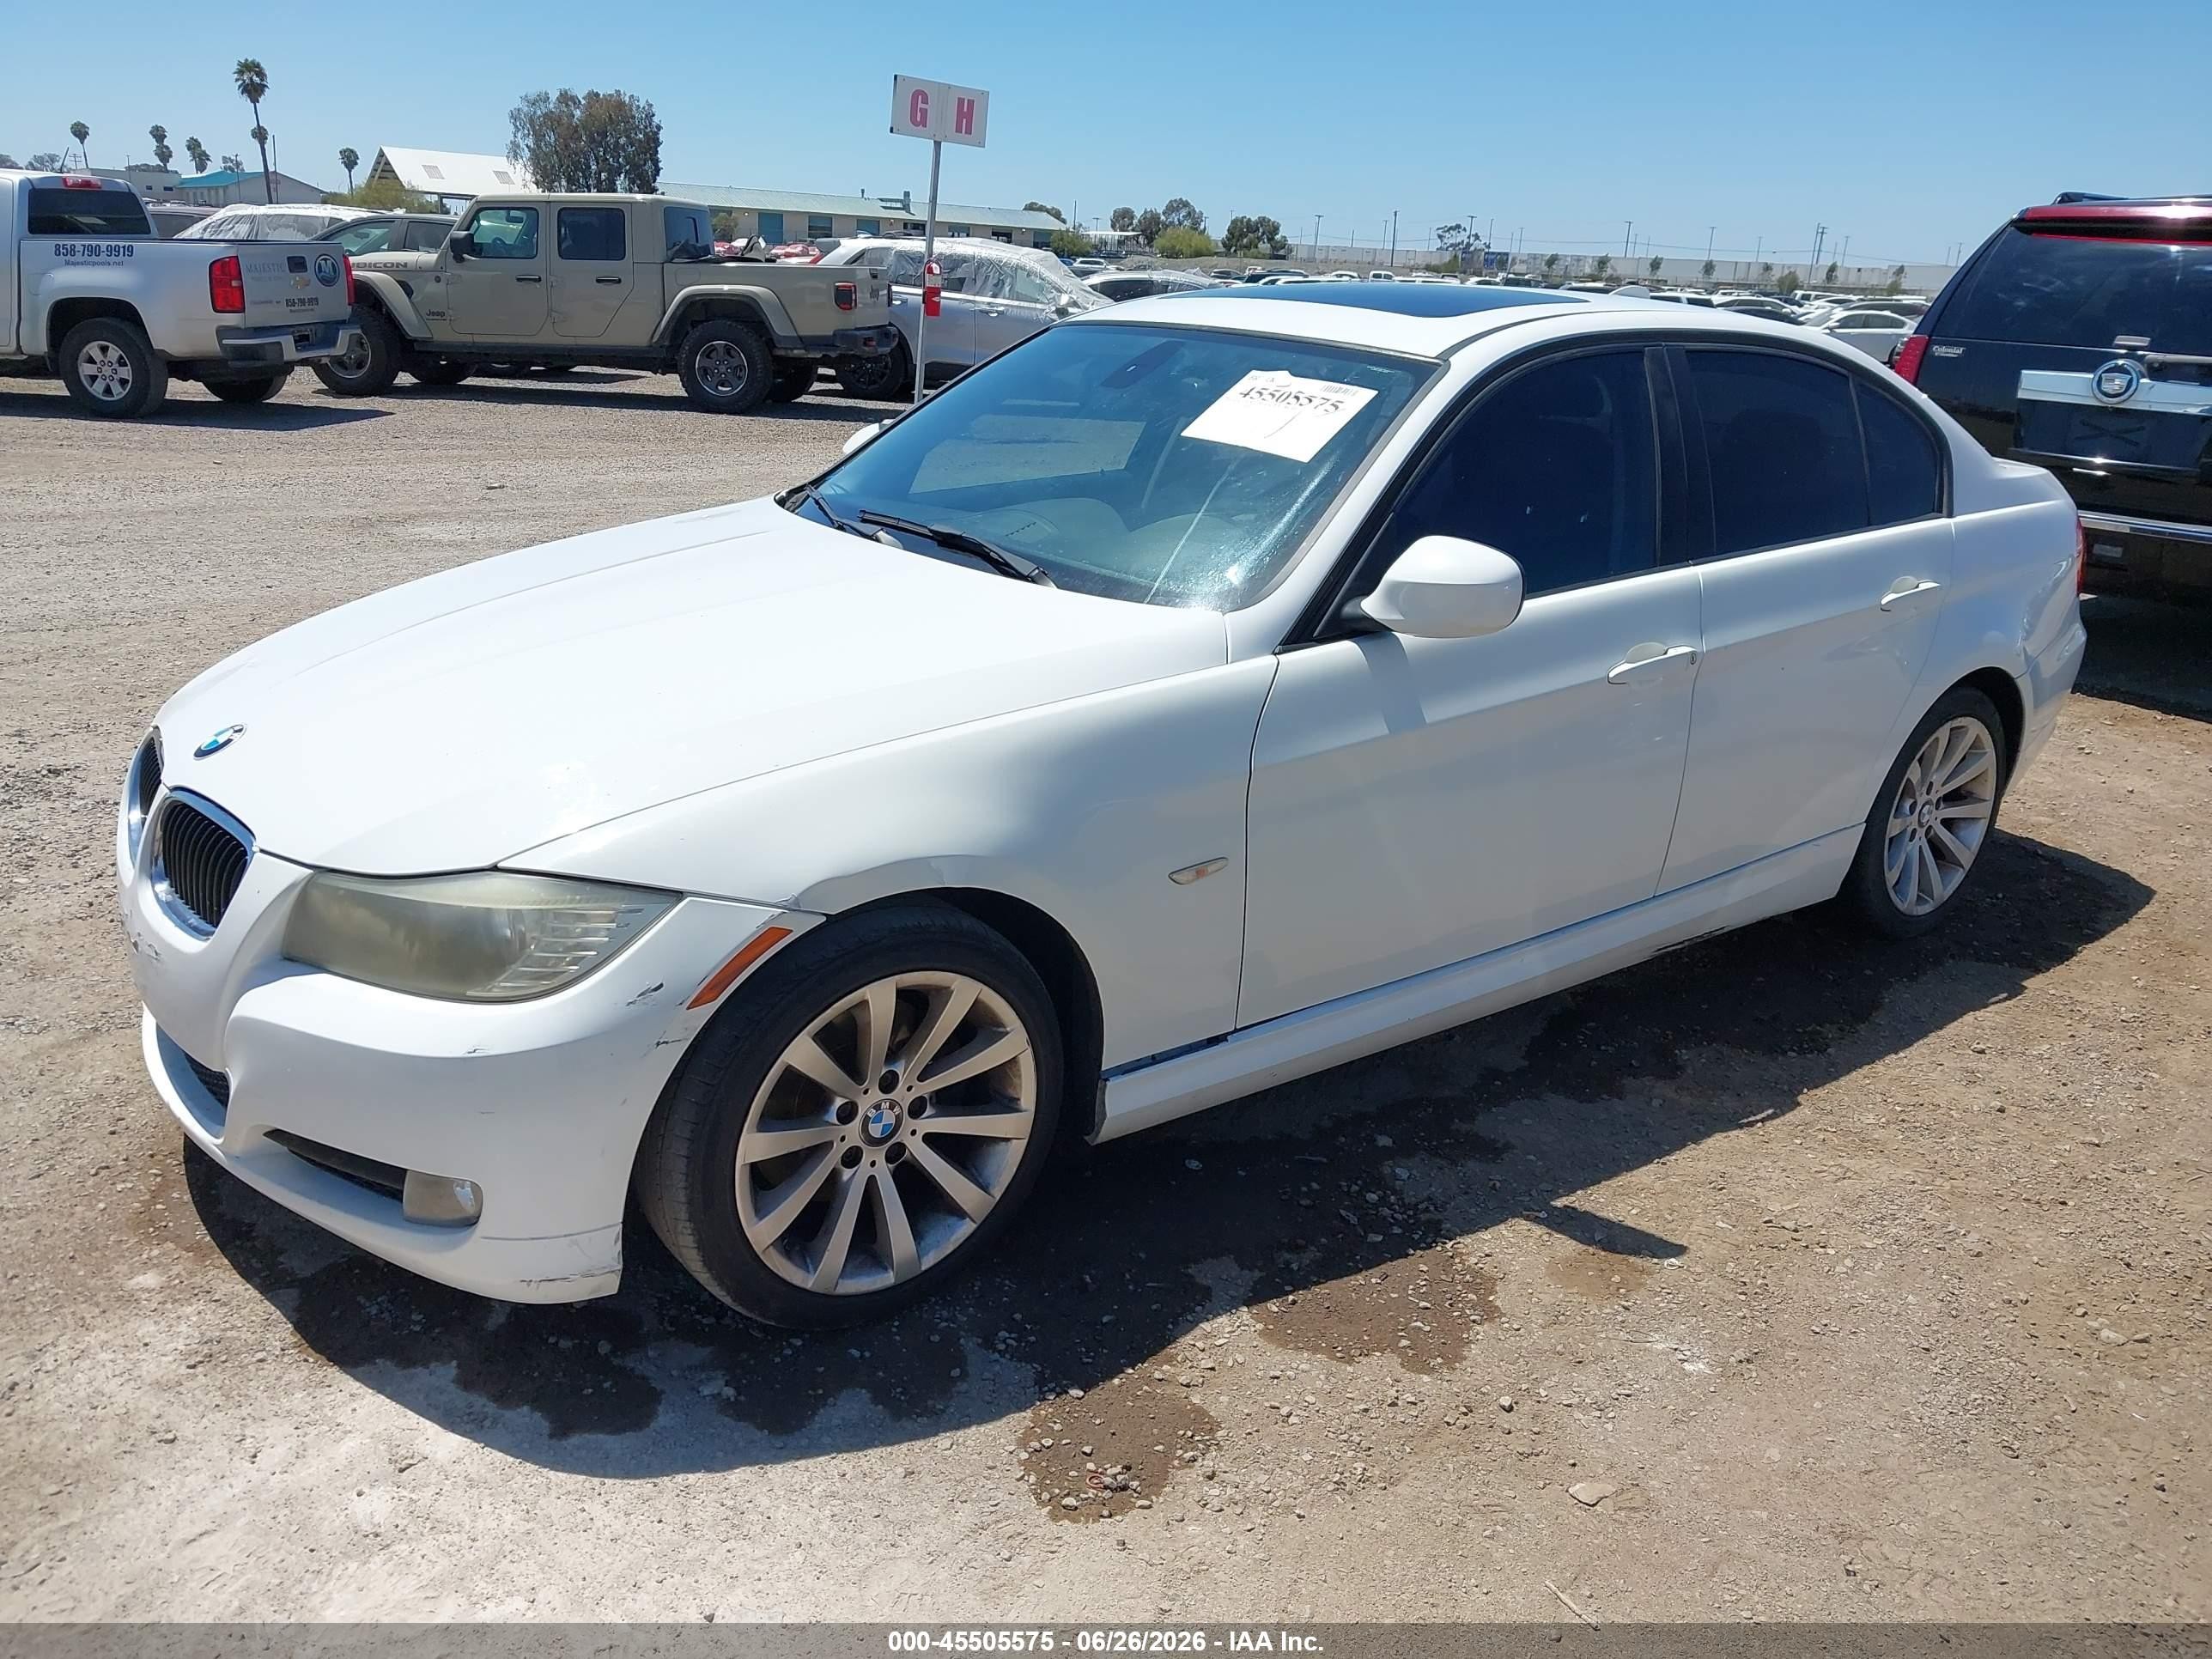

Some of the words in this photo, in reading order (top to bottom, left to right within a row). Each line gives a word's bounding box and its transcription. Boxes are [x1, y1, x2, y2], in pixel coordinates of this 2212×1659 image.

[910, 88, 929, 128] G
[955, 97, 975, 136] H
[54, 243, 134, 257] 858-790-9919
[1239, 386, 1346, 413] 45505575
[867, 1102, 901, 1117] BMW
